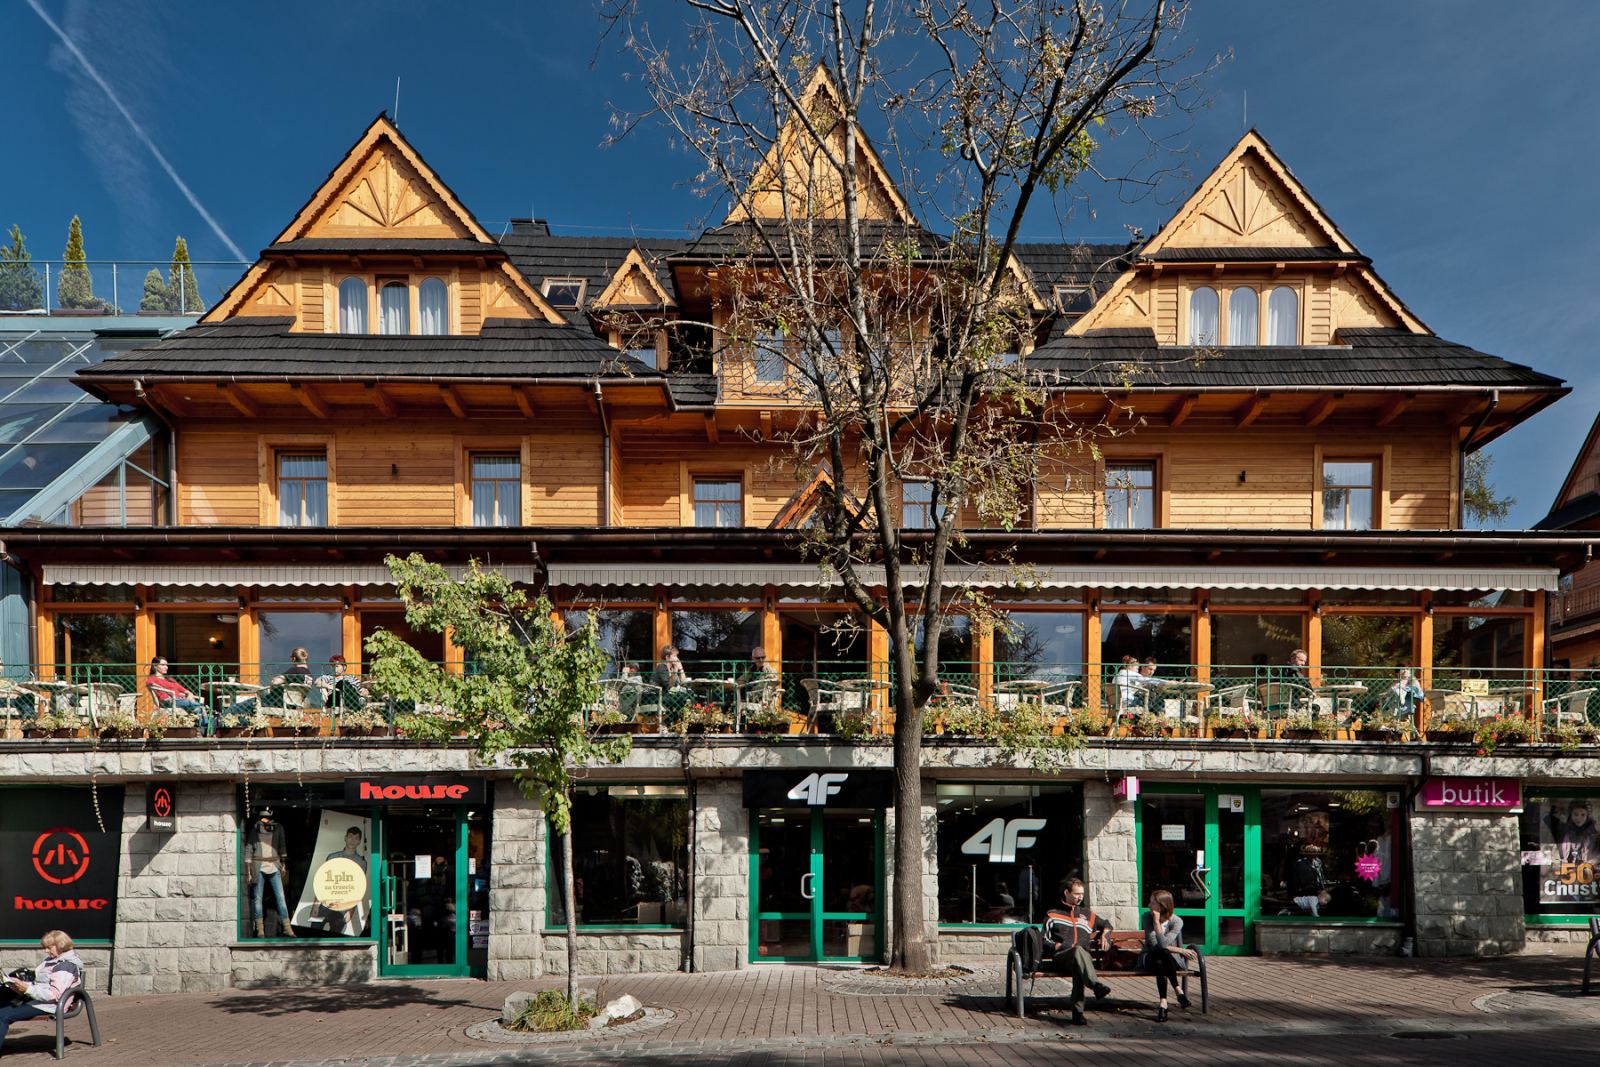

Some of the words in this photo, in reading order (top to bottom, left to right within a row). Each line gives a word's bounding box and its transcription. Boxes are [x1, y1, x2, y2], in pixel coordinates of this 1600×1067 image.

[360, 781, 470, 800] house
[787, 772, 849, 806] 4F
[1442, 781, 1505, 804] butik
[961, 817, 1048, 863] 4F
[1544, 880, 1600, 896] Chust
[14, 896, 109, 910] house
